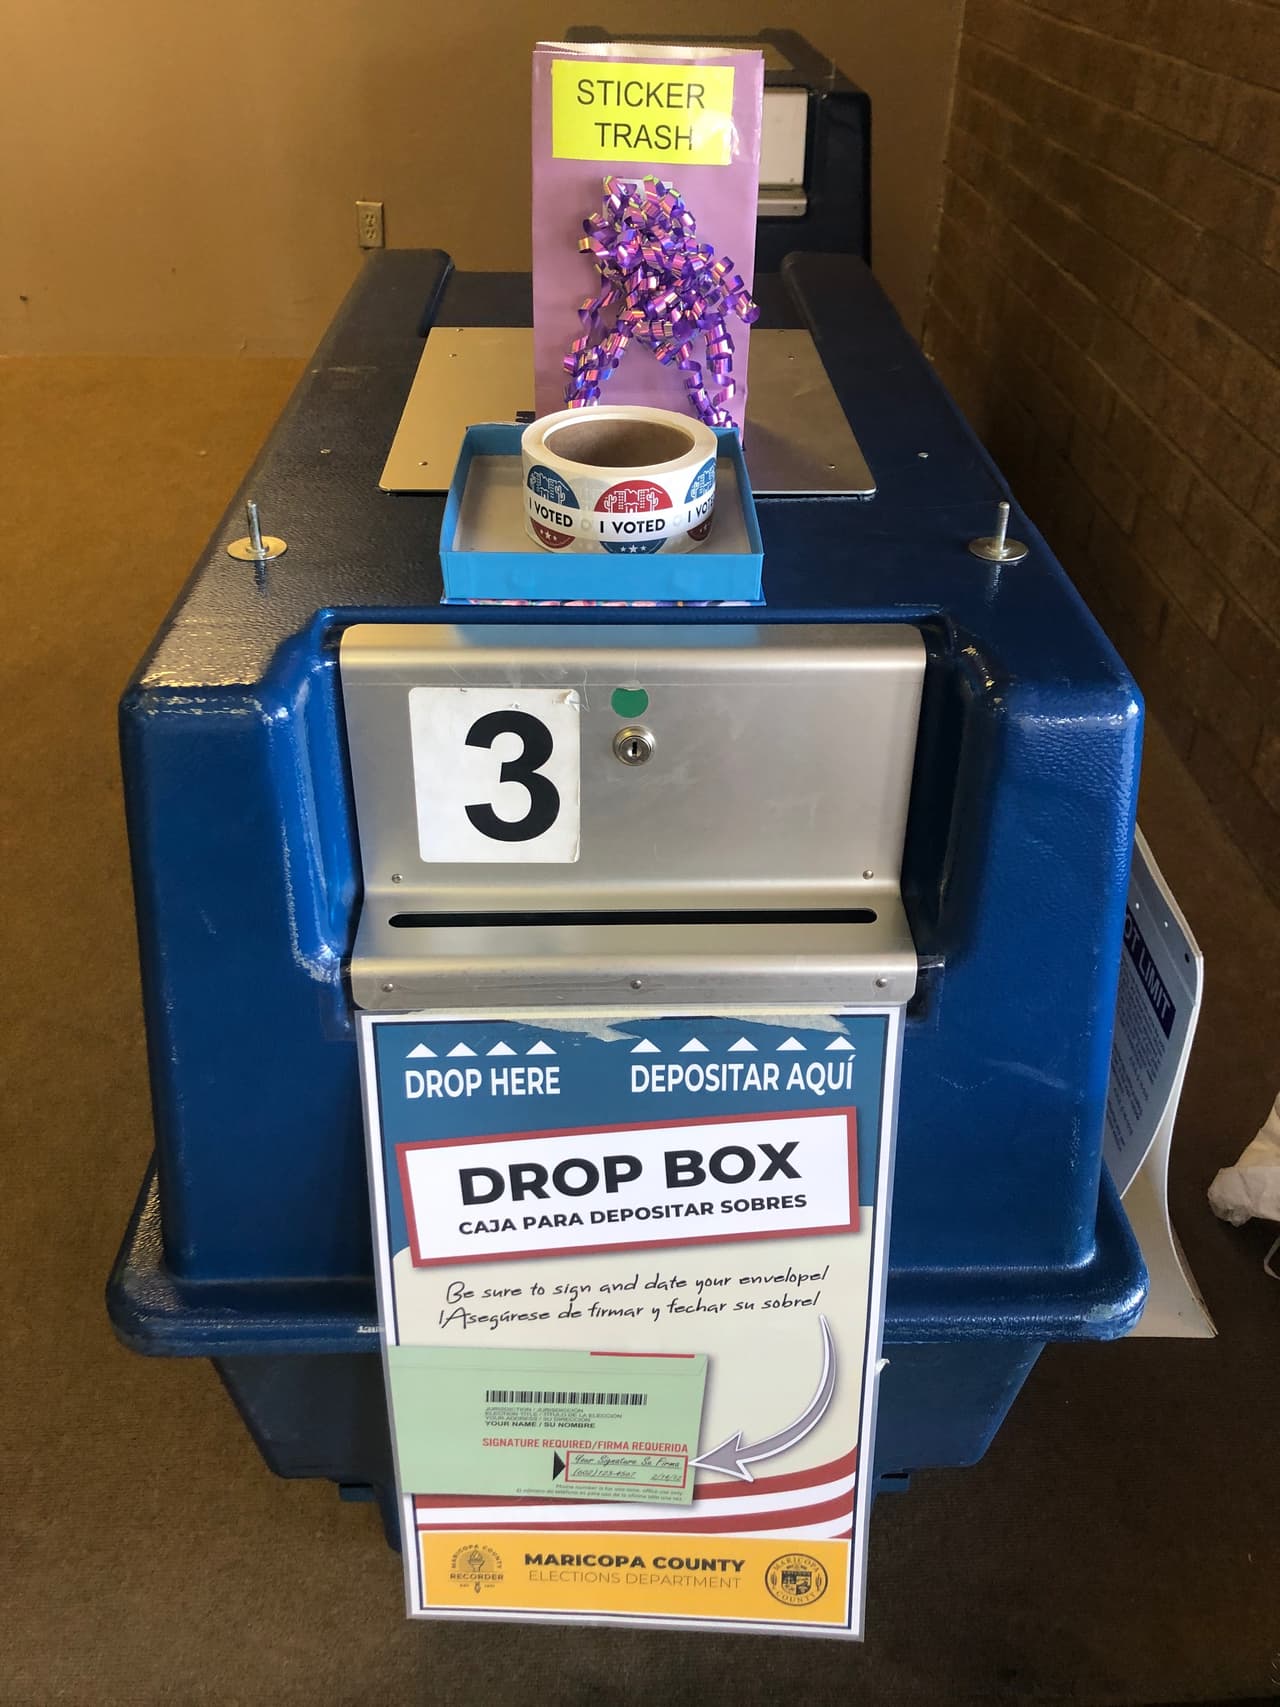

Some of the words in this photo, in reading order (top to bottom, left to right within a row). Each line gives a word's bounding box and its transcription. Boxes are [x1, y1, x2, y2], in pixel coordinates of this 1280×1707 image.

[577, 79, 705, 109] STICKER
[594, 122, 693, 150] TRASH
[535, 501, 573, 527] VOTED
[600, 520, 604, 533] I
[612, 518, 666, 534] VOTED
[465, 710, 560, 842] 3
[1139, 947, 1171, 1019] LIMIT
[405, 1067, 482, 1099] DROP
[490, 1066, 561, 1096] HERE
[631, 1062, 779, 1093] DEPOSITAR
[786, 1054, 856, 1096] AQUÍ
[458, 1154, 643, 1206] DROP
[664, 1141, 802, 1188] BOX
[458, 1218, 517, 1235] CAJA
[523, 1213, 584, 1230] PARA
[590, 1202, 714, 1225] DEPOSITAR
[720, 1194, 807, 1214] SOBRES
[446, 1281, 475, 1304] Be
[481, 1287, 523, 1298] sure
[531, 1282, 545, 1296] to
[552, 1282, 591, 1301] sign
[599, 1273, 639, 1293] and
[644, 1272, 687, 1291] date
[695, 1275, 732, 1295] your
[558, 1302, 582, 1319] de
[588, 1301, 644, 1319] firmar
[651, 1307, 660, 1321] y
[667, 1297, 727, 1314] fechar
[733, 1302, 754, 1311] su
[482, 1438, 540, 1448] SIGNATURE
[542, 1439, 629, 1450] REQUIRED/FIRMA
[632, 1443, 689, 1453] REQUERIDA
[598, 1455, 637, 1466] Signature
[524, 1553, 646, 1568] MARICOPA
[652, 1556, 746, 1572] COUNTY
[773, 1556, 819, 1573] MARICOPA
[529, 1569, 620, 1584] ELECTIONS
[626, 1573, 742, 1589] DEPARTMENT
[776, 1591, 816, 1603] COUNTY
